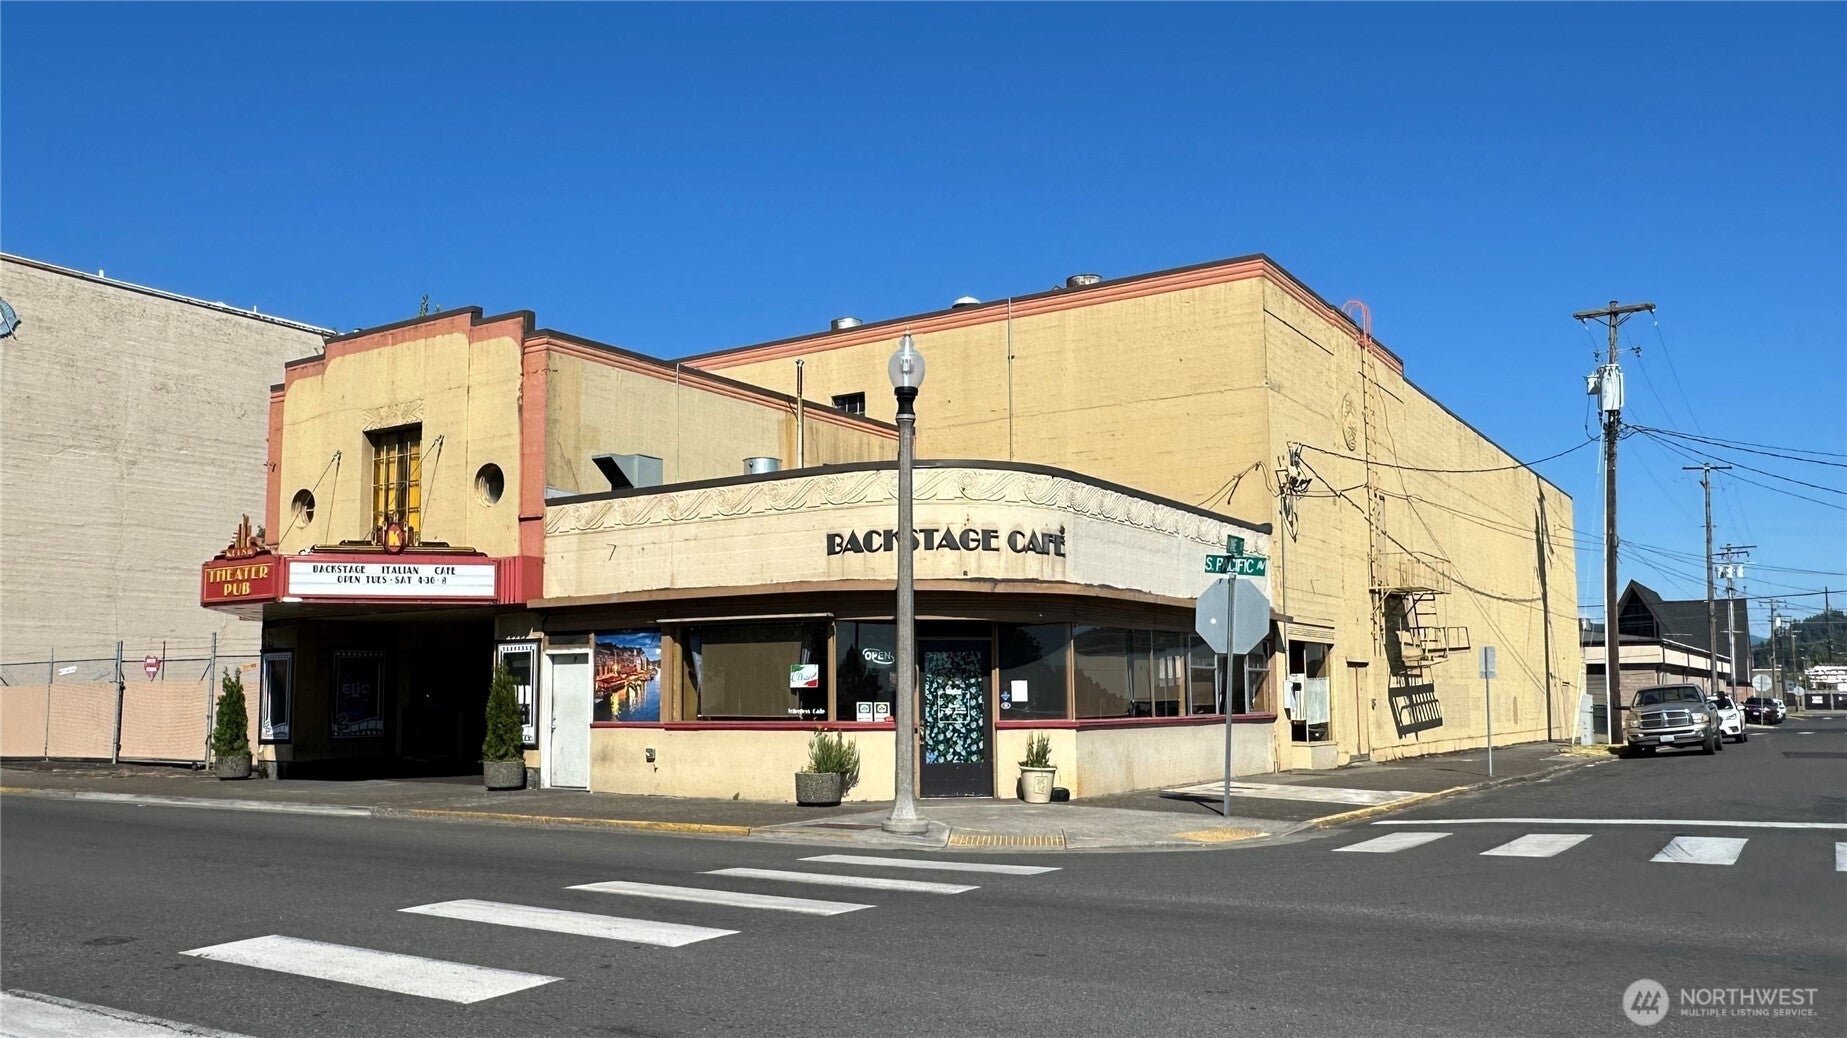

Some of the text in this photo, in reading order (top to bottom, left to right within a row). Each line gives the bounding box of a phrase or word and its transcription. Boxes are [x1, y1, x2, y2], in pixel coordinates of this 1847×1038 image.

[312, 565, 456, 575] BACKSTAGE ITALIAN CAFE
[1215, 557, 1254, 573] PACIFIC
[206, 565, 269, 583] THEATER
[337, 575, 361, 584] OPEN
[223, 582, 251, 596] PUB
[864, 651, 891, 660] OPEN
